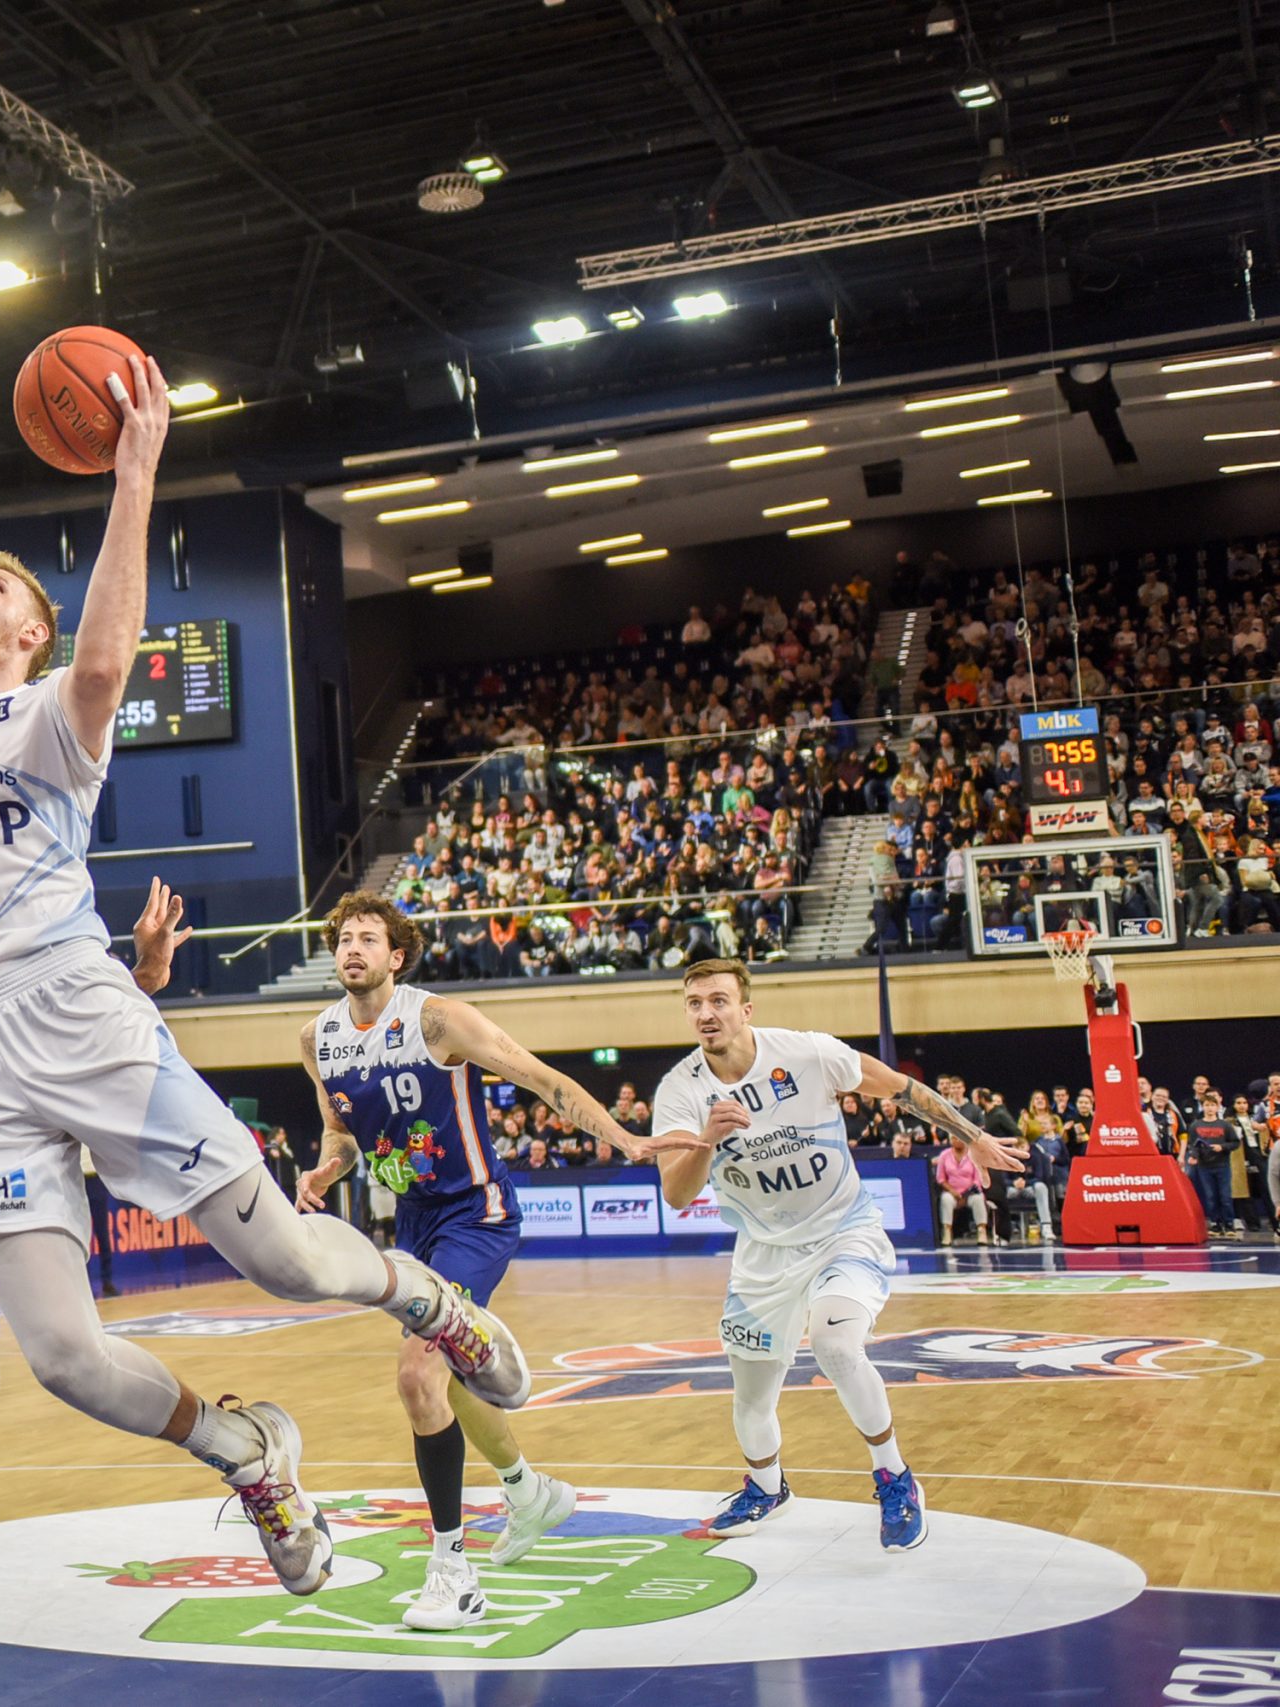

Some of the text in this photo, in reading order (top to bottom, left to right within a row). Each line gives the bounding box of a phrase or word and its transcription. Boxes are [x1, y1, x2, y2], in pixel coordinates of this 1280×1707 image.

[149, 654, 167, 679] 2
[117, 699, 158, 726] :55
[1044, 740, 1097, 763] 7:55
[380, 1072, 422, 1114] 19
[729, 1083, 763, 1112] 10
[777, 1088, 797, 1101] BBL
[744, 1125, 798, 1149] koenig
[1100, 1138, 1139, 1147] Vermögen
[1111, 1127, 1138, 1137] OSPA
[751, 1134, 816, 1162] solutions
[756, 1152, 828, 1194] MLP
[1082, 1173, 1163, 1187] Gemeinsam
[520, 1198, 573, 1213] arvato
[1083, 1190, 1166, 1203] investieren!
[624, 1577, 717, 1600] 1921
[1163, 1648, 1280, 1707] SPA
